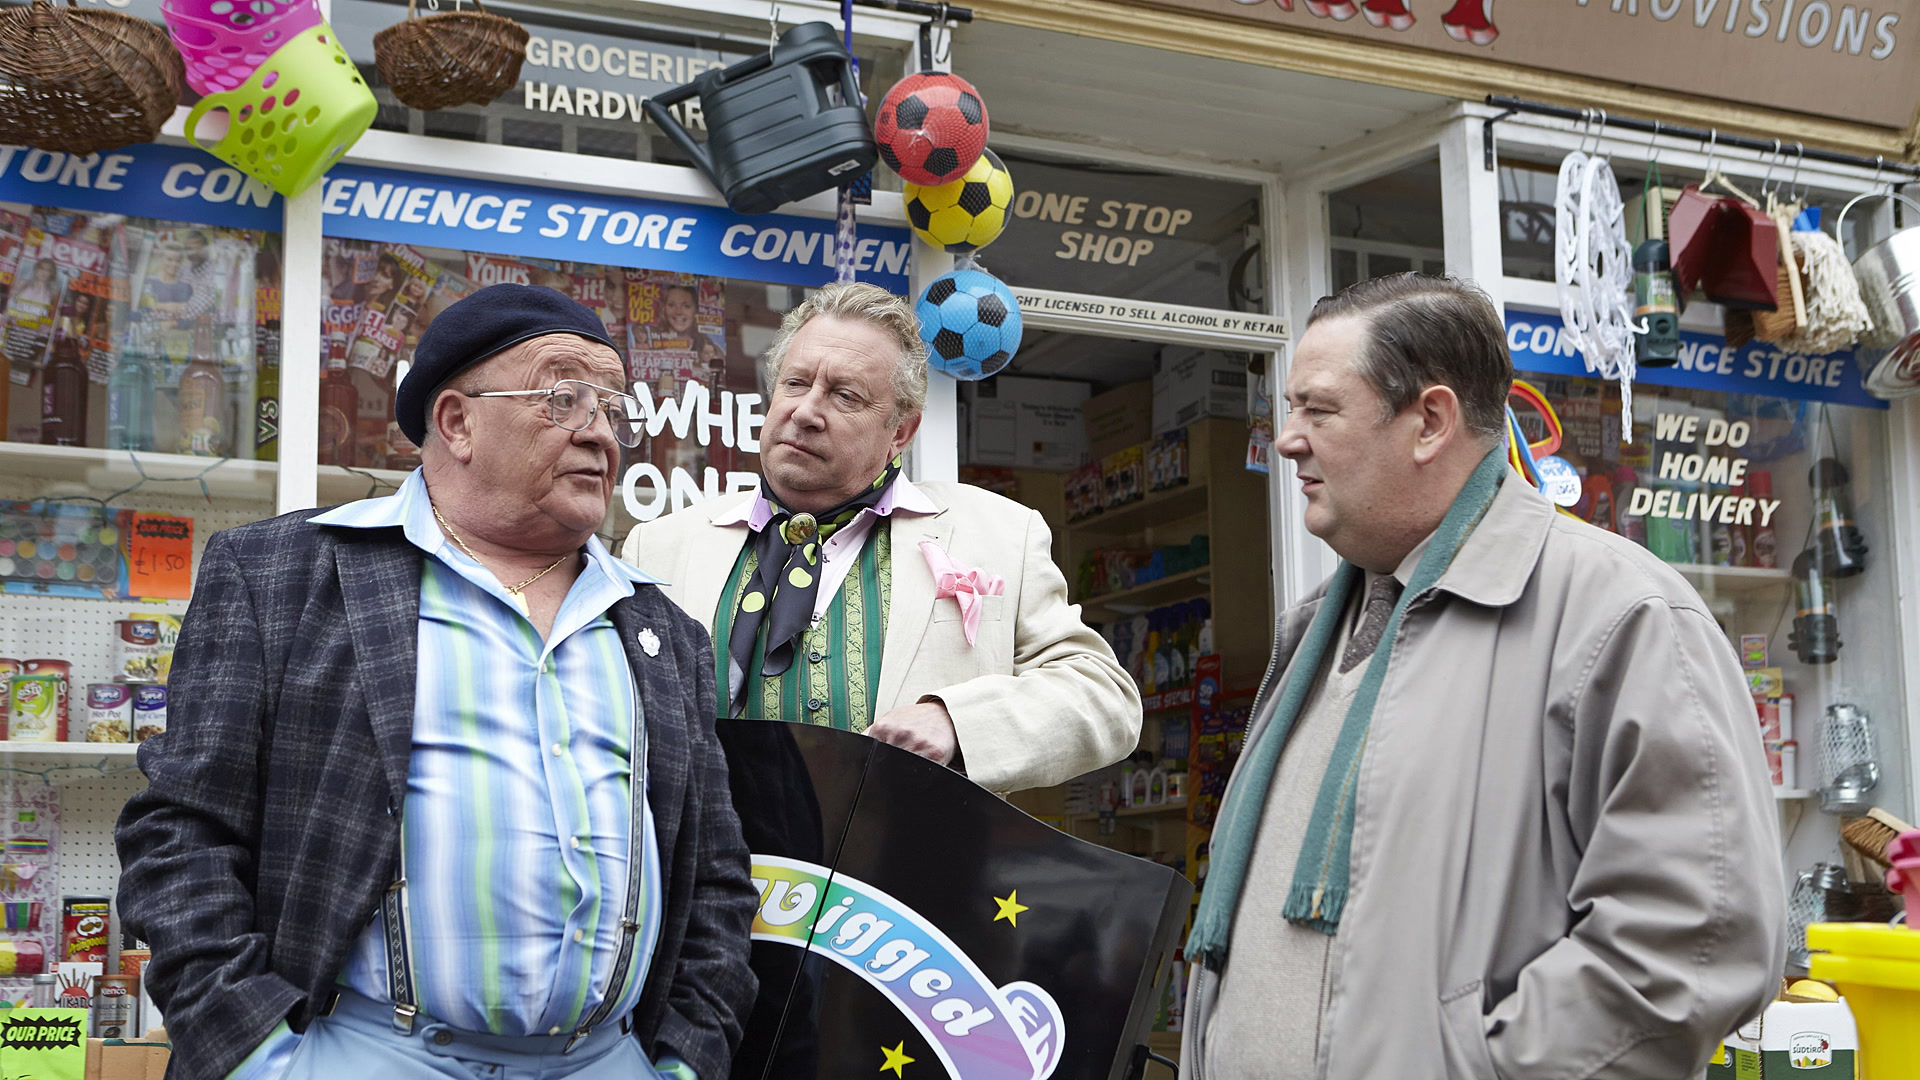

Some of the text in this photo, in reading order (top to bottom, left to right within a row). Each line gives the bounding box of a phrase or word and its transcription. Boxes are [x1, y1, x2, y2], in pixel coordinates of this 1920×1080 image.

[540, 204, 697, 252] STORE
[1014, 190, 1192, 236] ONE STOP
[1055, 231, 1154, 267] SHOP
[628, 284, 660, 298] Pick
[629, 297, 654, 310] Me
[629, 309, 655, 324] Up!
[1045, 298, 1104, 315] LICENSED
[1110, 306, 1126, 317] TO
[1128, 307, 1157, 321] SELL
[1162, 311, 1219, 328] ALCOHOL
[1223, 318, 1241, 330] BY
[1243, 320, 1285, 335] RETAIL
[631, 356, 694, 370] HEAREAT
[1744, 349, 1846, 388] STORE
[1656, 413, 1699, 444] WE
[1704, 417, 1750, 449] DO
[1659, 452, 1748, 487] HOME
[1629, 486, 1781, 528] DELIVERY
[6, 1025, 77, 1042] OUR PRICE
